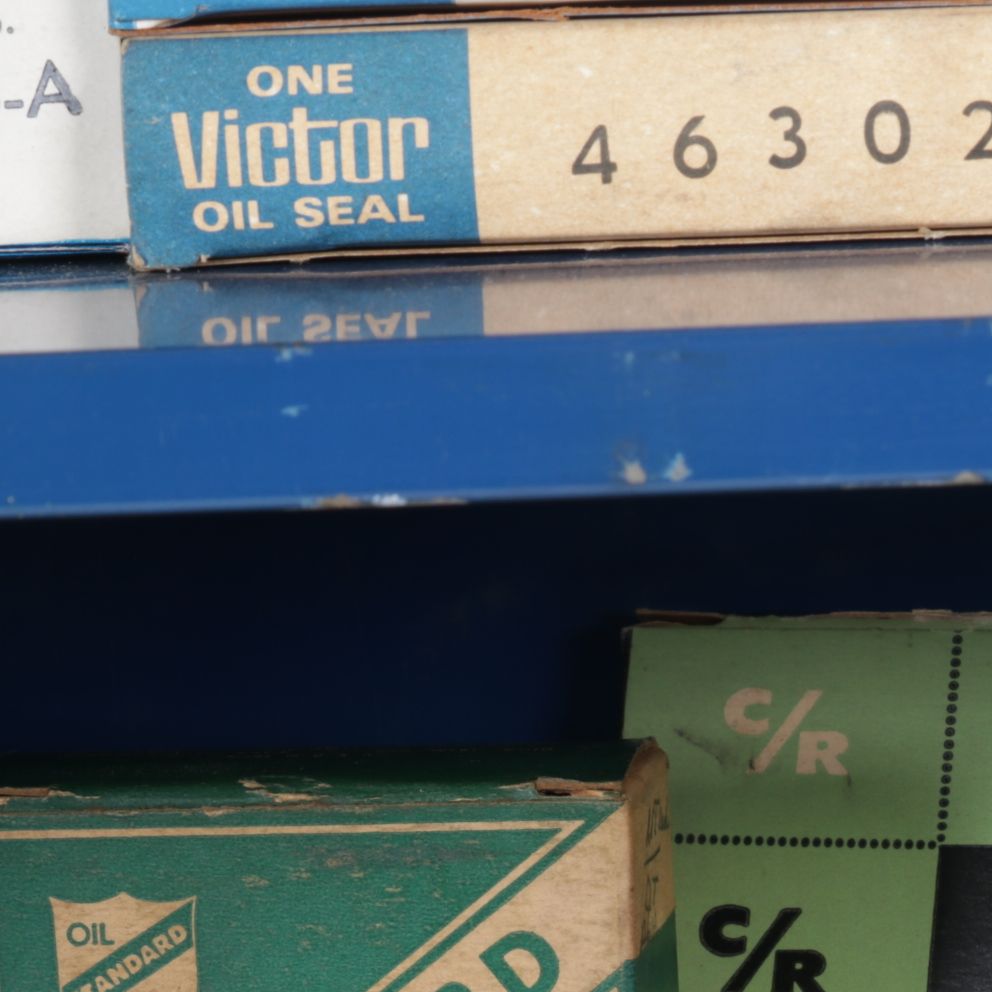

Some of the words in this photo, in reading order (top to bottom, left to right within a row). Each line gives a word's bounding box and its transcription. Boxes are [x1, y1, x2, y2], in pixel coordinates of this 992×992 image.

[246, 63, 354, 97] ONE
[171, 107, 430, 190] Victor
[193, 199, 274, 232] OIL
[294, 193, 425, 227] SEAL
[723, 687, 850, 775] C/R
[66, 921, 116, 947] OIL
